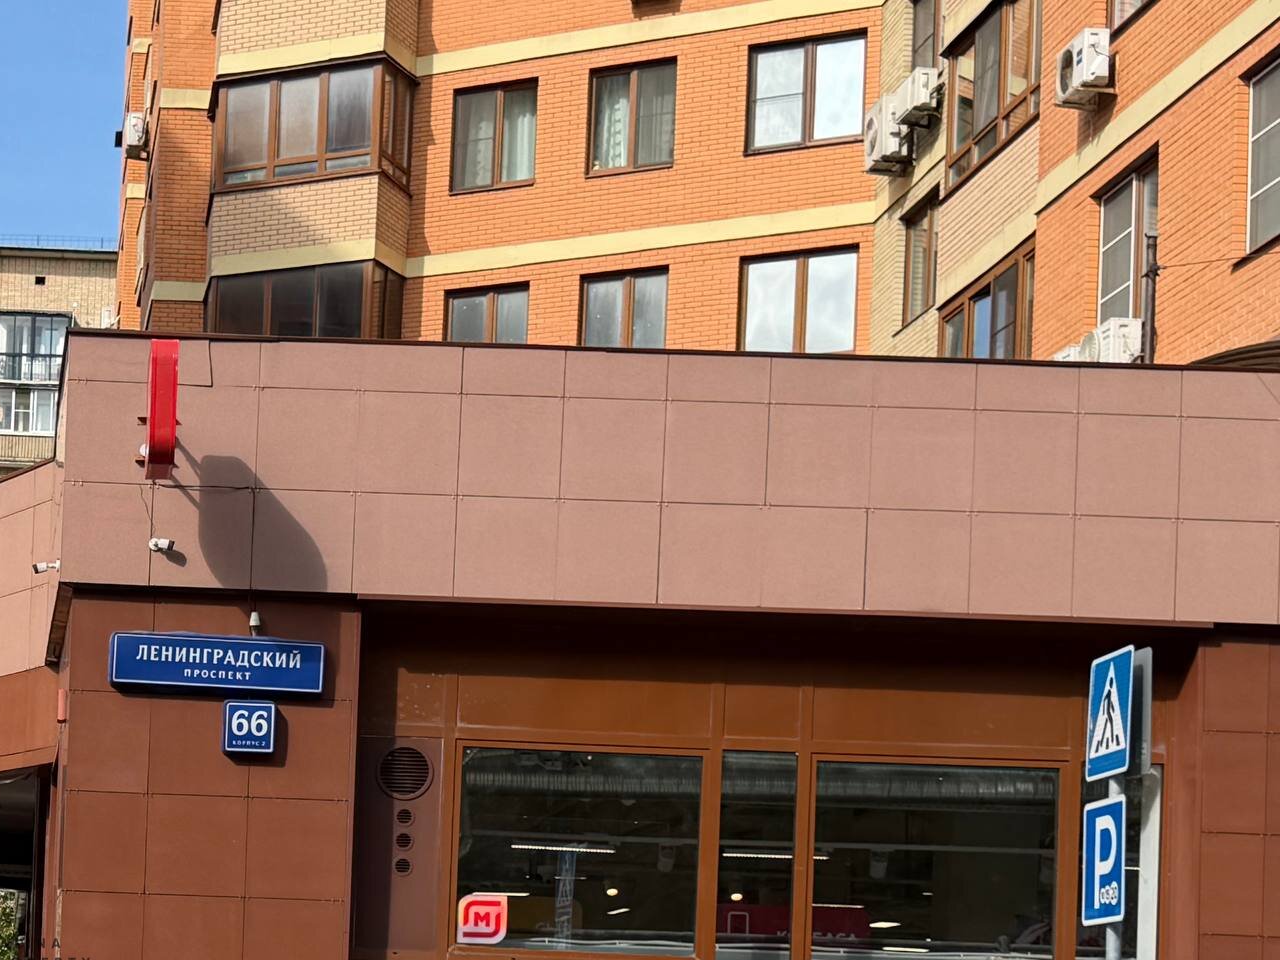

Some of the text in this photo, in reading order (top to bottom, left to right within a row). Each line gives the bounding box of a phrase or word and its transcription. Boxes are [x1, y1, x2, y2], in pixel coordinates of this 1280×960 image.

[136, 644, 302, 669] ЛЕНИНГРАДСКИЙ
[183, 668, 252, 681] ПРОСПЕКТ
[231, 709, 268, 737] 66
